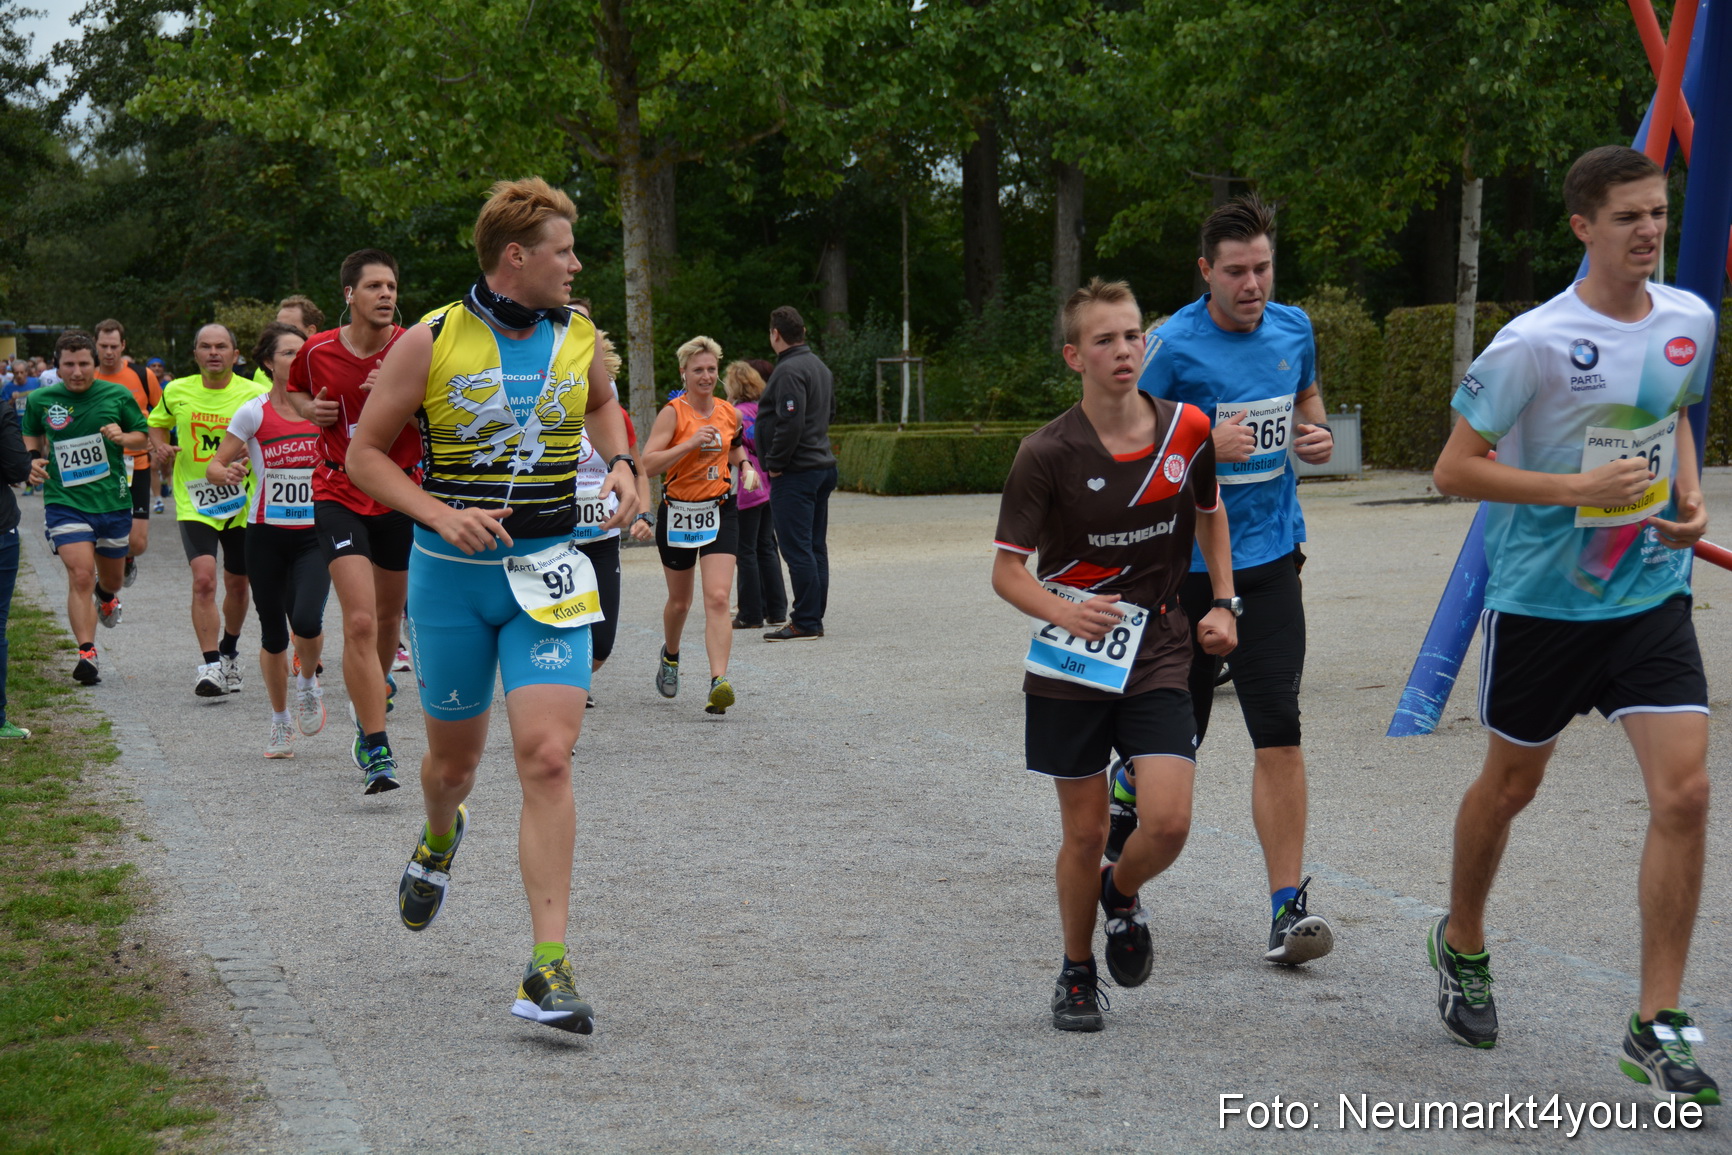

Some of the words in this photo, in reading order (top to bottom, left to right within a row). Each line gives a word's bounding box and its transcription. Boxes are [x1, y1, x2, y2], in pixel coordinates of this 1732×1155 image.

[502, 373, 541, 381] cocoon
[1570, 374, 1606, 386] PARTL
[1571, 384, 1608, 392] Neumarkt
[192, 411, 232, 424] Müller
[1250, 406, 1284, 418] Neumarkt
[202, 434, 221, 451] M
[265, 440, 317, 459] MUSCAT
[1588, 437, 1628, 449] PARTL
[60, 446, 103, 469] 2498
[267, 458, 284, 468] Road
[286, 455, 315, 463] Runners
[1232, 458, 1278, 473] Christian
[73, 468, 96, 479] Rainer
[119, 475, 127, 499] Geek
[272, 483, 313, 503] 200
[576, 495, 599, 503] eumark
[207, 501, 241, 516] Wolfgang
[285, 508, 308, 519] Birgit
[673, 511, 715, 530] 2198
[572, 528, 592, 538] Steffi
[685, 533, 703, 542] Maria
[538, 550, 570, 569] Neumarkt
[543, 563, 575, 599] 93
[553, 601, 587, 620] Klaus
[1060, 656, 1086, 674] Jan
